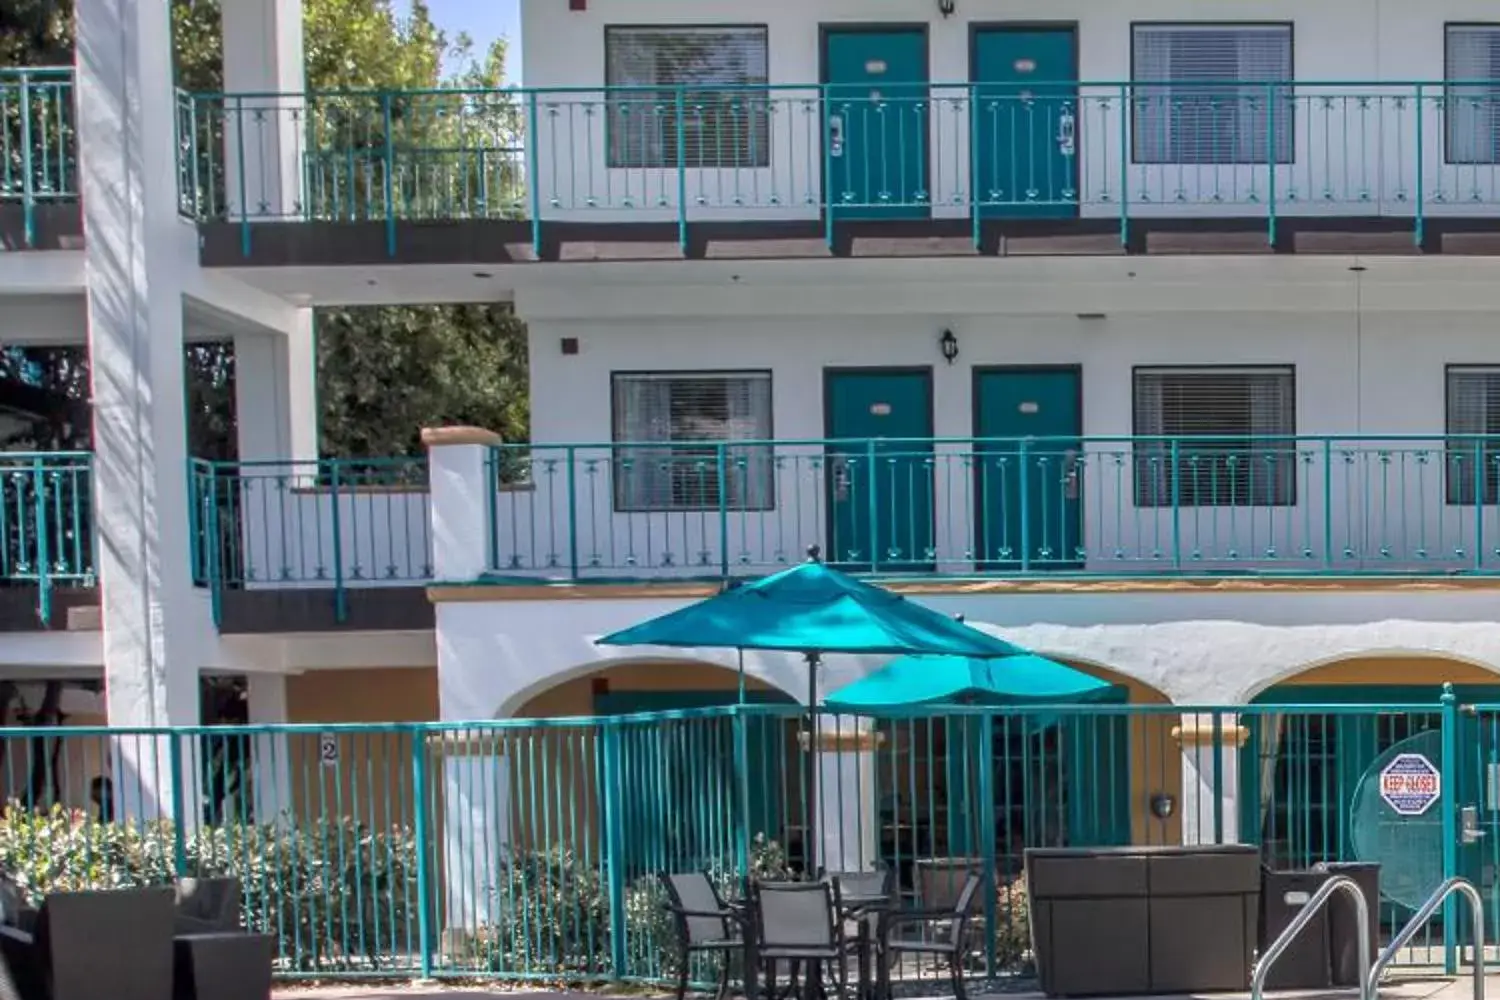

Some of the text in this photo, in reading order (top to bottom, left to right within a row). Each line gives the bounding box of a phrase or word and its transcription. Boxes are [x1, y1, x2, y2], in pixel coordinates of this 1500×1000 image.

[323, 742, 335, 760] 2
[1383, 775, 1437, 792] KEEP CLOSED
